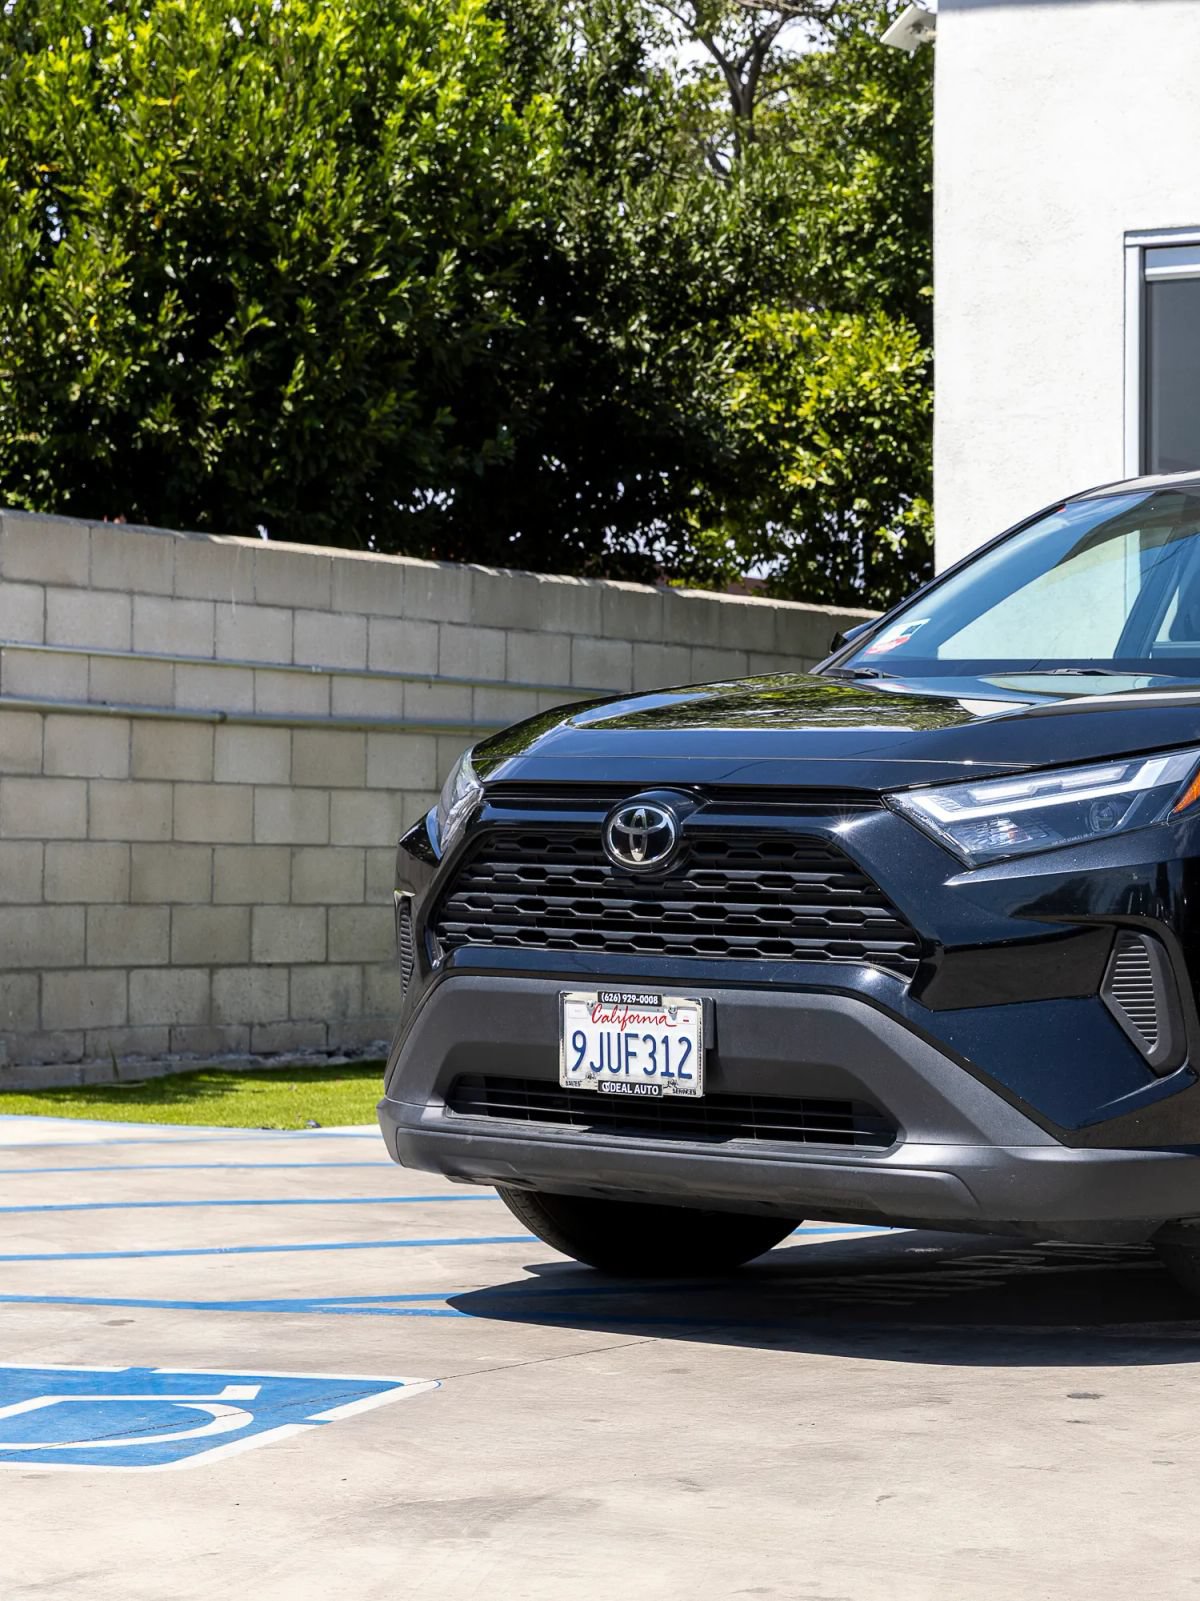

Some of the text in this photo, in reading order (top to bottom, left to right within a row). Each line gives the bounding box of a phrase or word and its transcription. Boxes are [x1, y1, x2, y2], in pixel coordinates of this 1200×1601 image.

[601, 992, 658, 1005] (626) 929-0008
[592, 1003, 678, 1032] California
[572, 1030, 693, 1080] 9JUF312
[634, 1083, 659, 1096] AUTO
